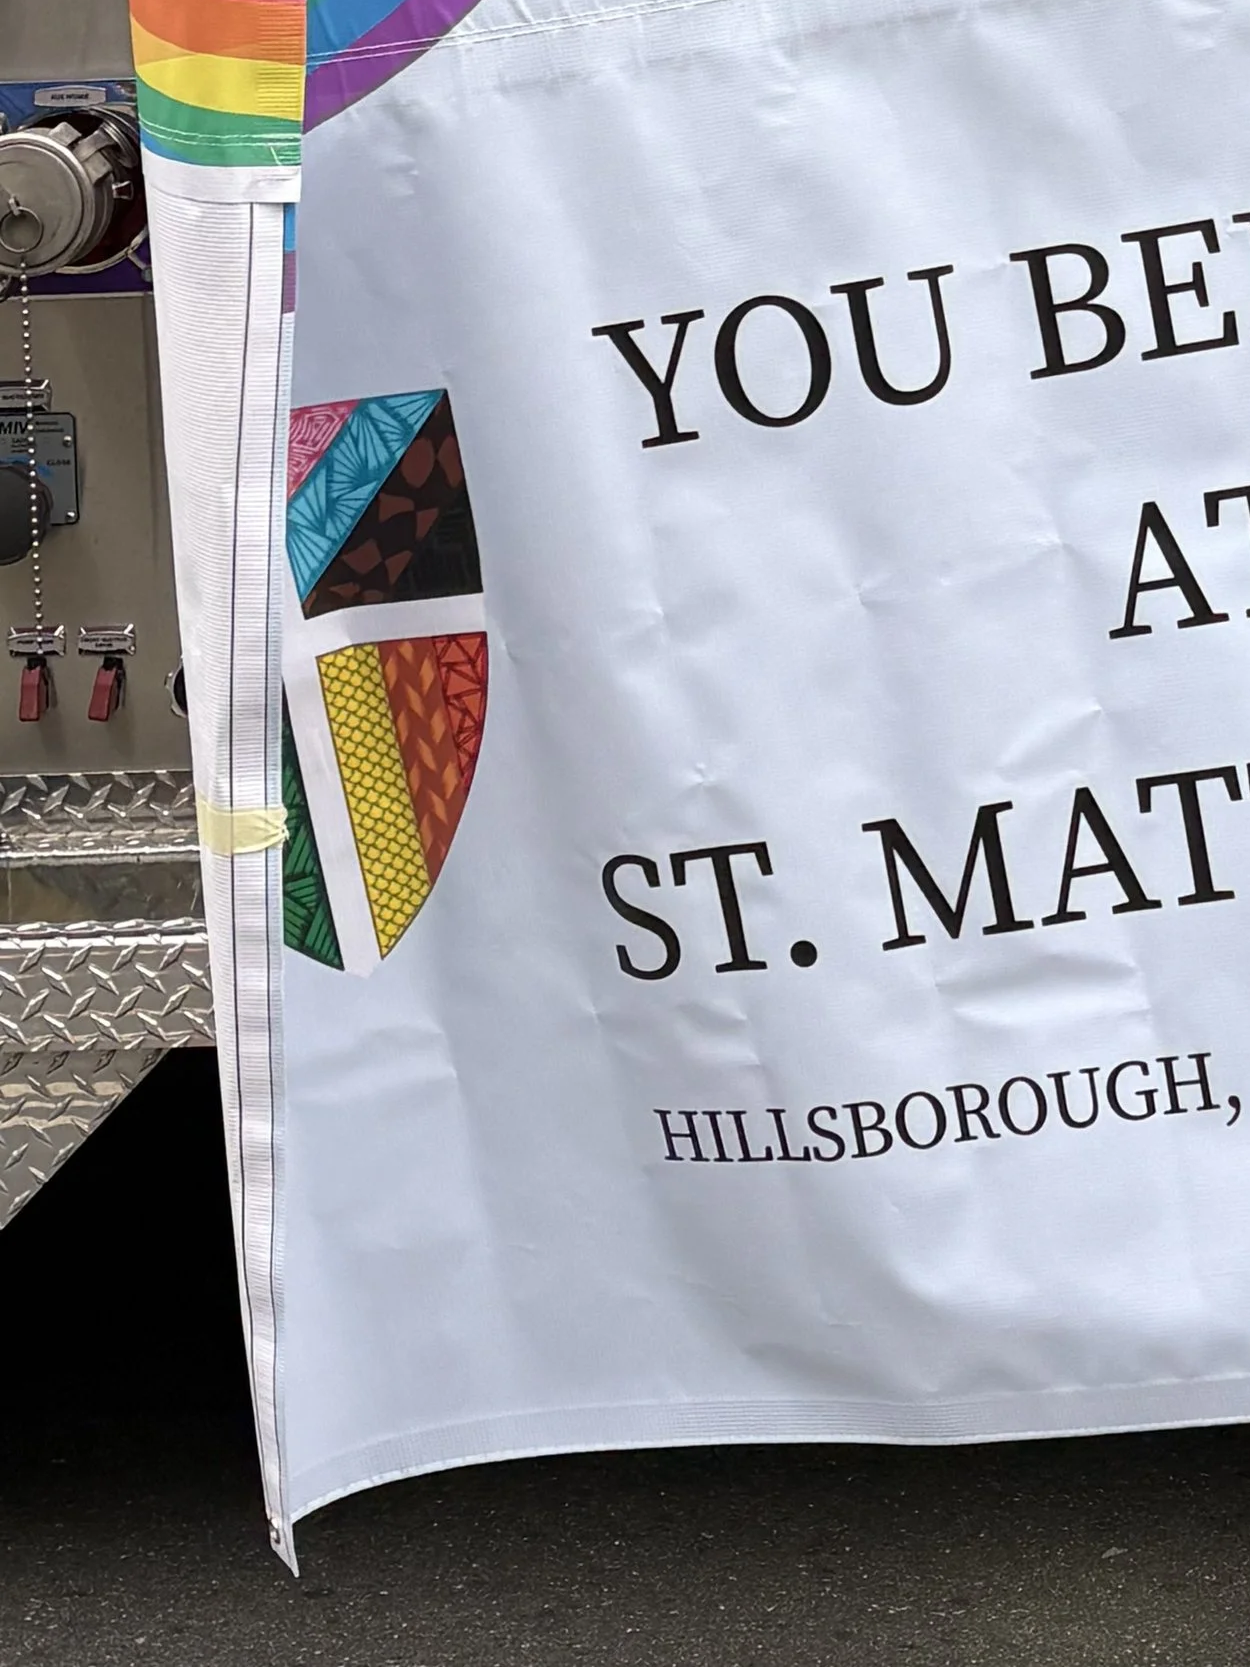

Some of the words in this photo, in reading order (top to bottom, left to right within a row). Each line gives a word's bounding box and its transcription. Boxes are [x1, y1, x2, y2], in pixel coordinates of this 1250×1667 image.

[591, 264, 954, 449] YOU
[601, 841, 818, 981] ST.
[653, 1052, 1241, 1163] HILLSBOROUGH,
